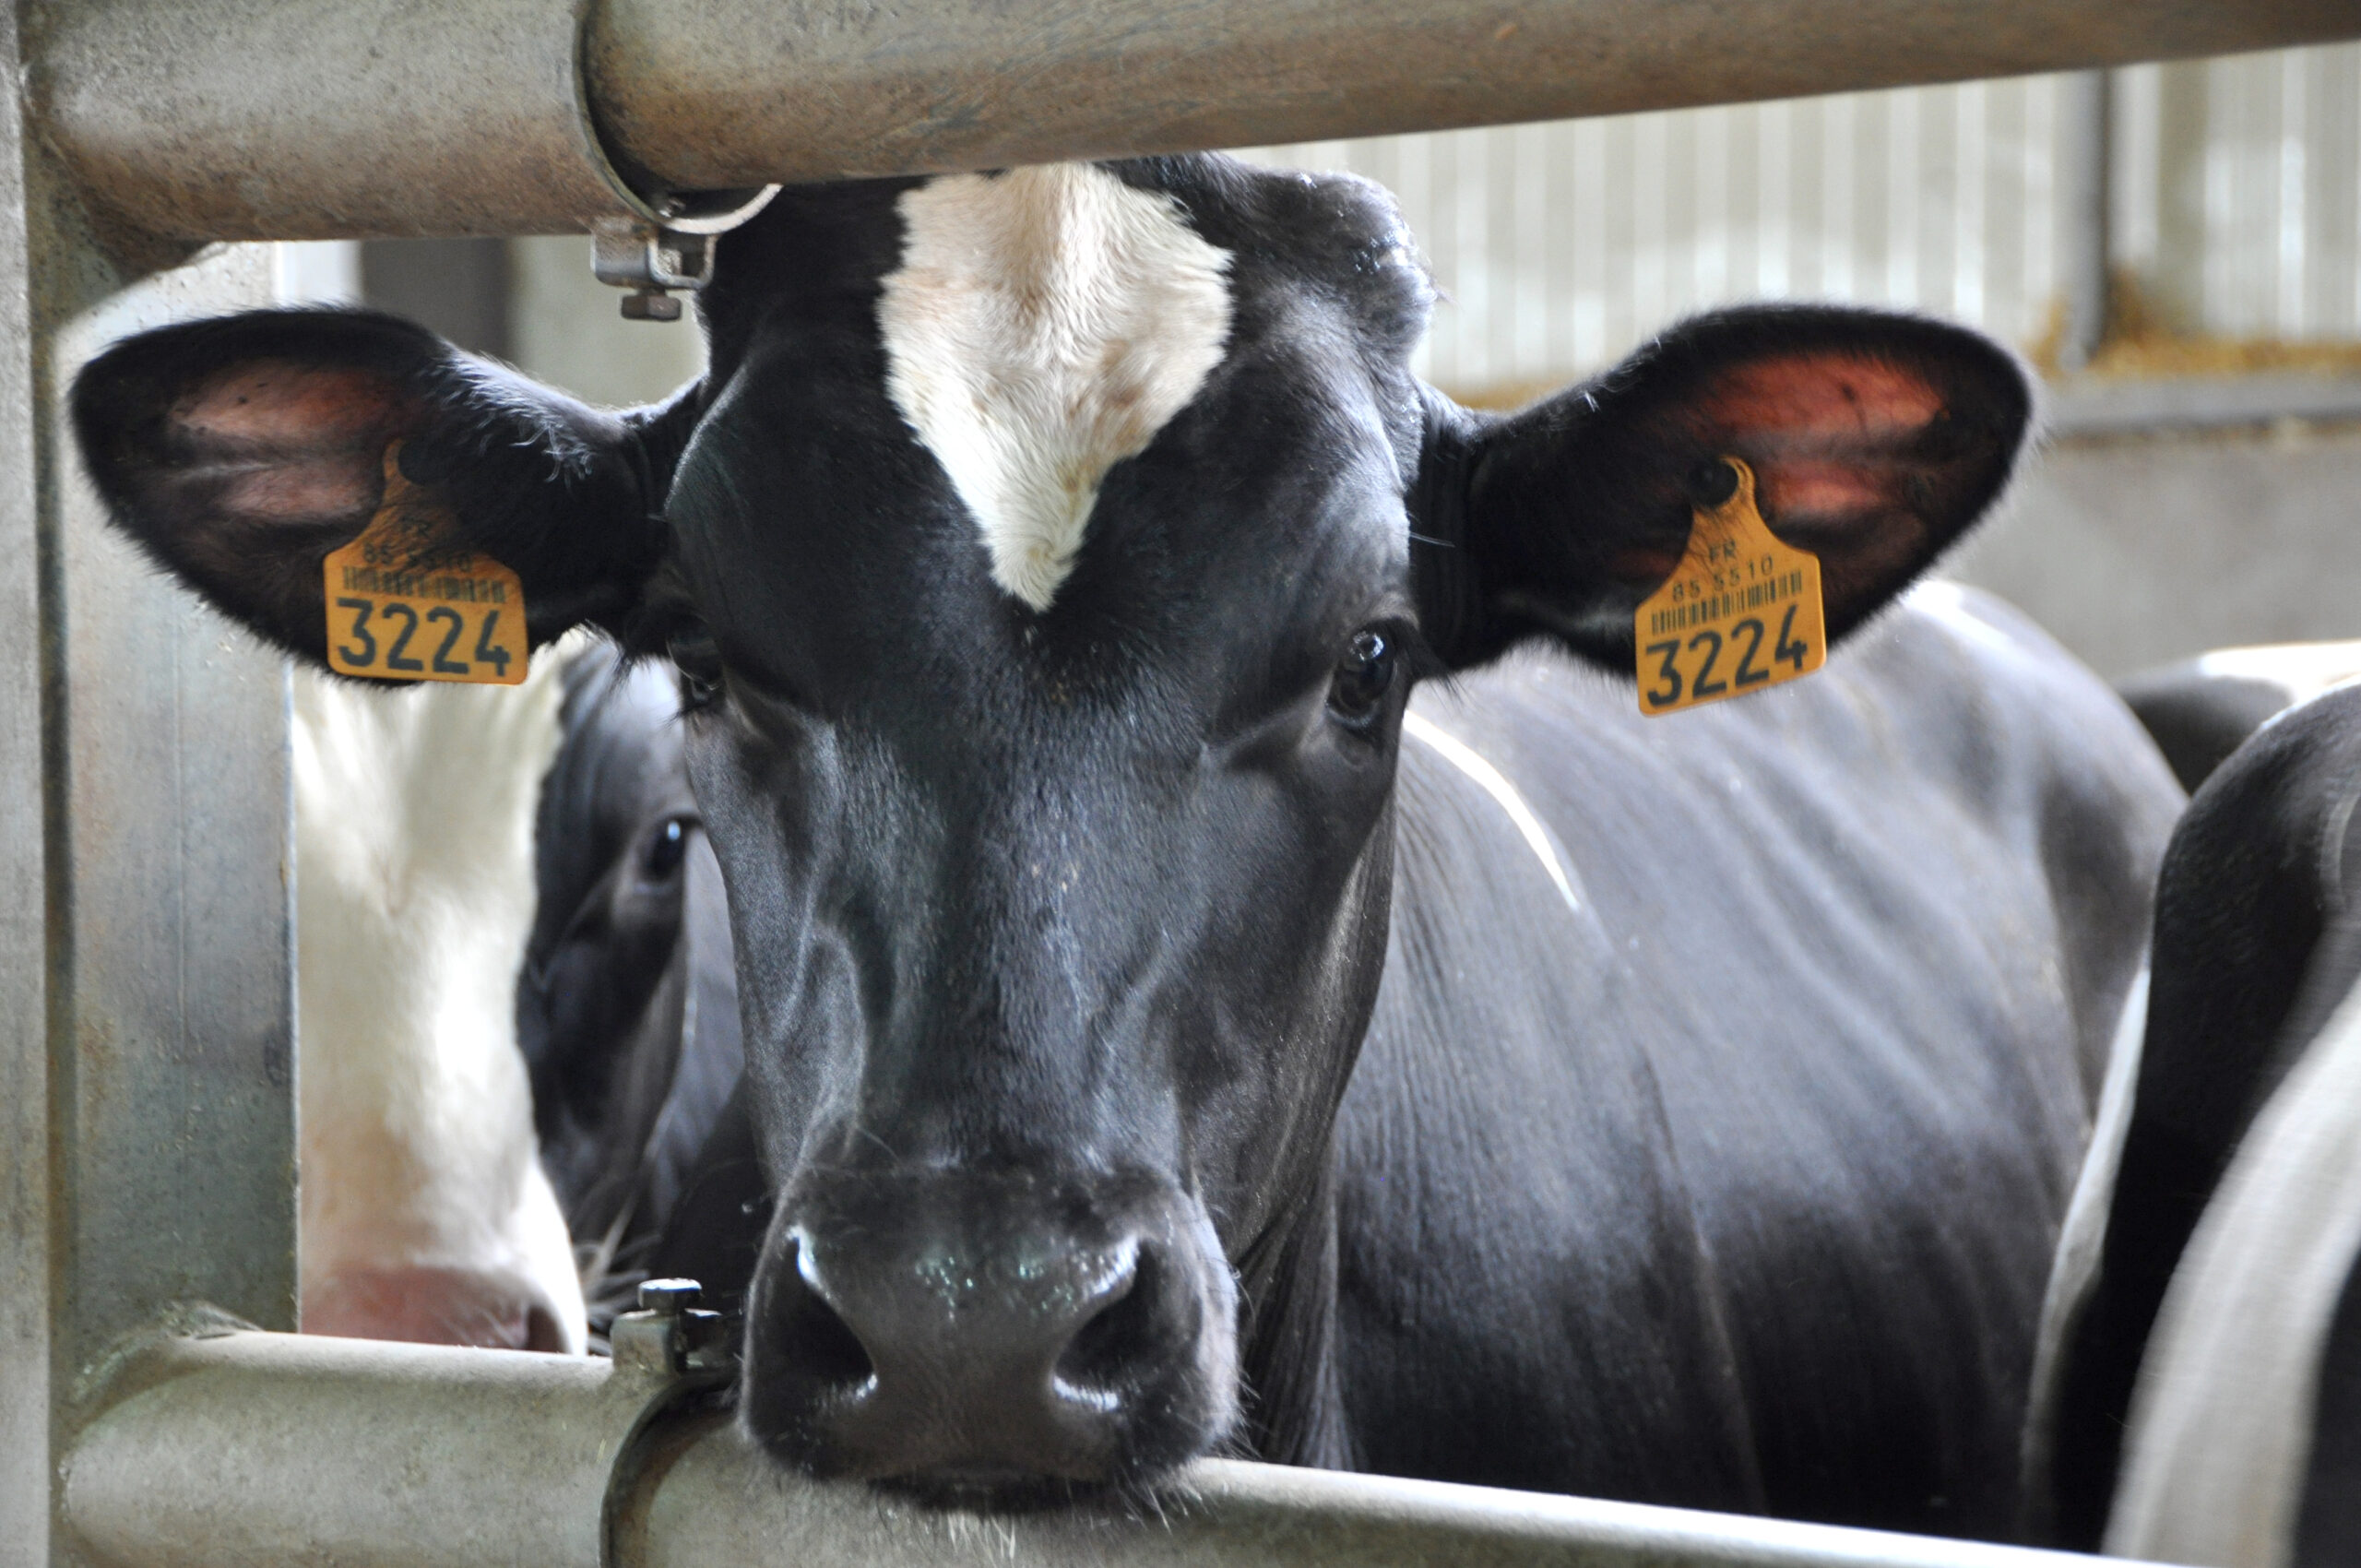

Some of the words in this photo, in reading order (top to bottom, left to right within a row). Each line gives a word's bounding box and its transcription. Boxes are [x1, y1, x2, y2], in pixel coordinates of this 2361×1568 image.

[1672, 579, 1702, 602] 85
[1712, 553, 1774, 592] 5510
[1708, 539, 1737, 564] FR
[336, 597, 512, 677] 3224
[1645, 604, 1809, 708] 3224
